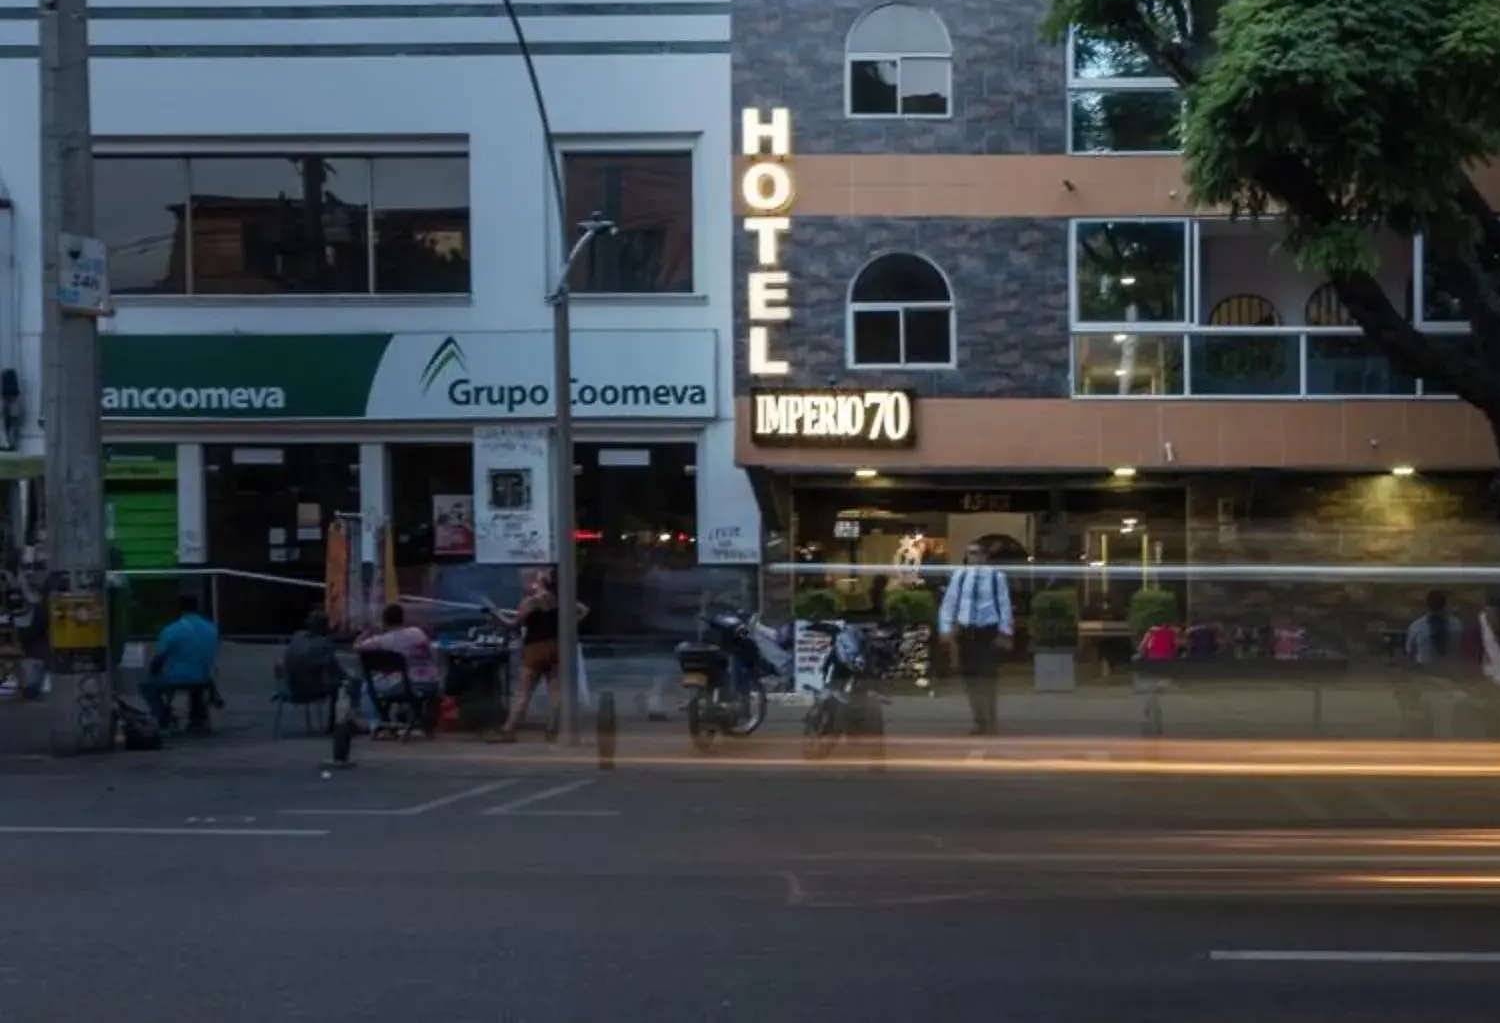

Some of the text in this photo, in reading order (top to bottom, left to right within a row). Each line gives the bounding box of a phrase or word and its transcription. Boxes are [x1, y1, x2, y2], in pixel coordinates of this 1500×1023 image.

[741, 107, 792, 374] HOTEL
[100, 385, 286, 410] ancoomeva
[447, 378, 549, 413] Grupo
[754, 390, 911, 441] IMPERIO 70
